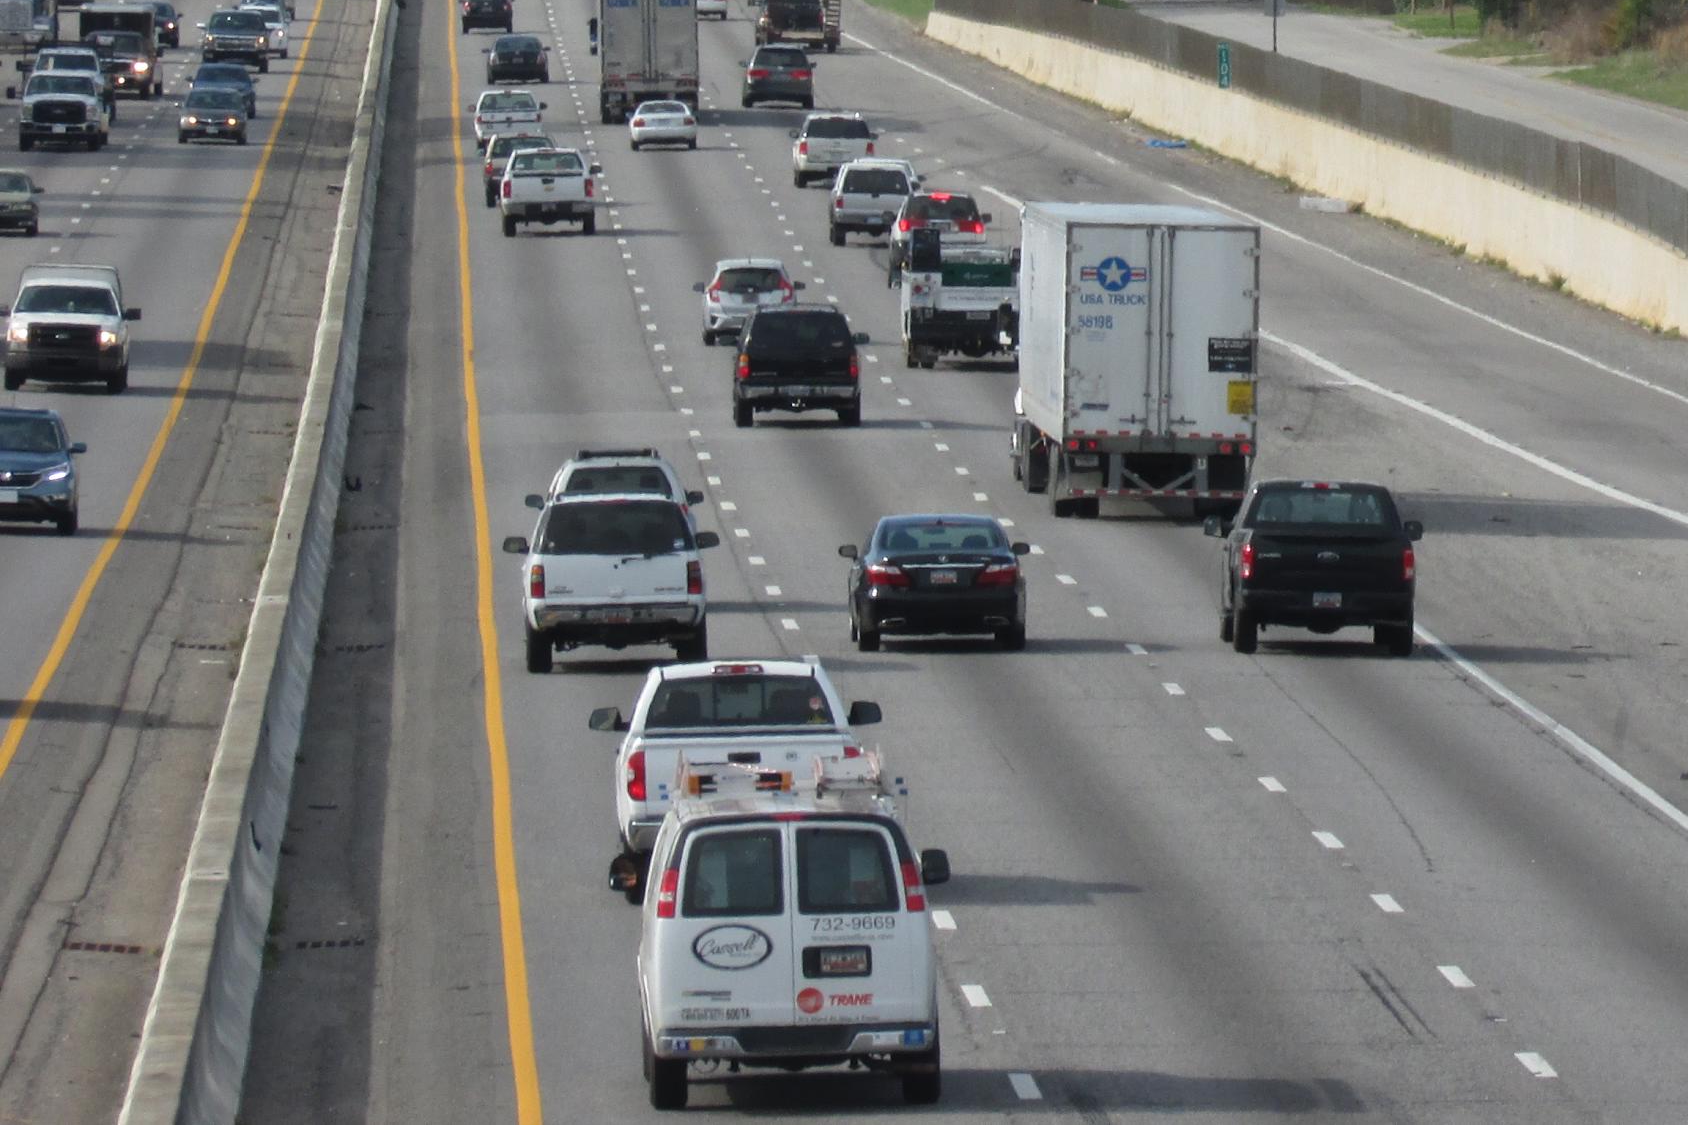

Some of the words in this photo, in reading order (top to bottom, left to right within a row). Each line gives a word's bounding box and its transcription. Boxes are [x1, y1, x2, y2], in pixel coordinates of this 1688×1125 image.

[1080, 294, 1103, 304] USA
[1108, 294, 1146, 305] TRUCK
[810, 915, 896, 931] 732-9669
[829, 993, 874, 1006] TRANE
